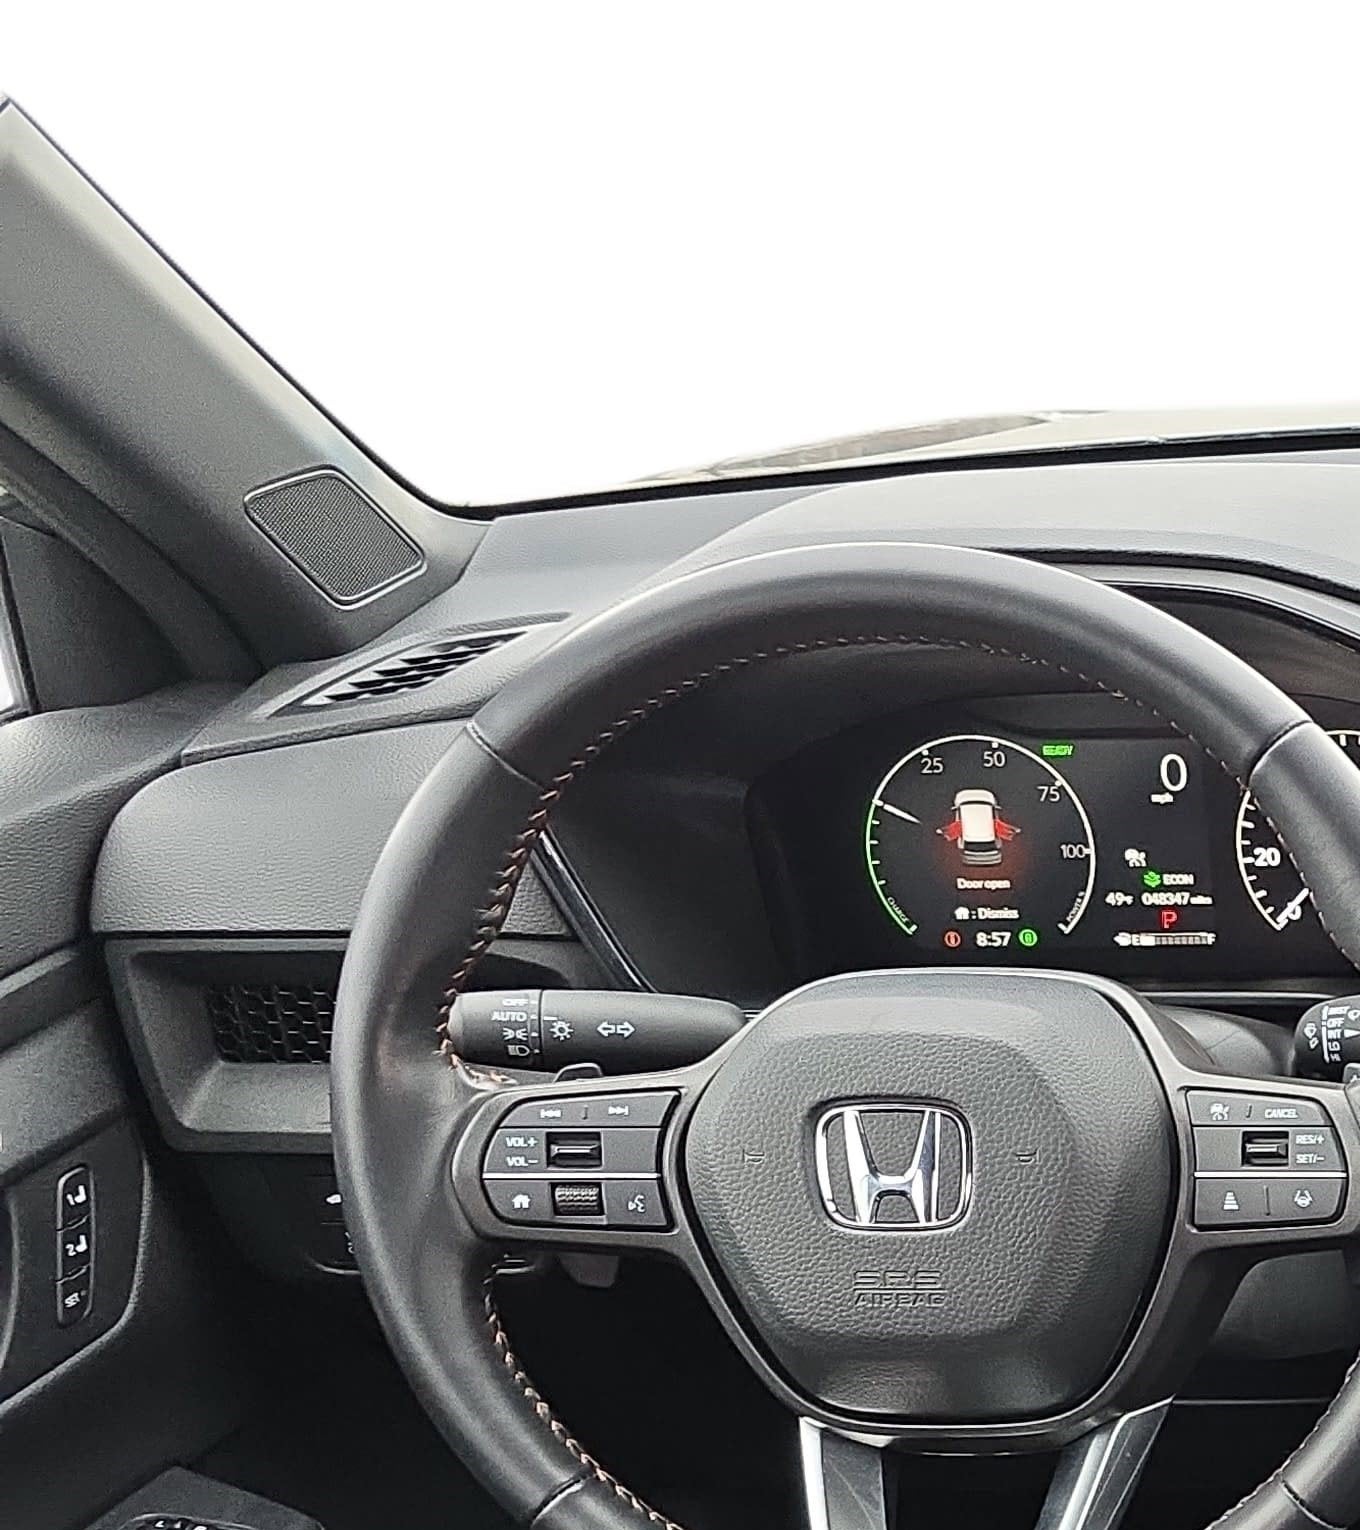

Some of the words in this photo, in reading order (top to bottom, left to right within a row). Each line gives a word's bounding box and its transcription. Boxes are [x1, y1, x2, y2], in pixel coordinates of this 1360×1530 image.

[920, 757, 944, 774] 25
[983, 751, 1006, 768] 50
[1160, 753, 1188, 791] 0
[1036, 785, 1061, 802] 75
[1060, 844, 1086, 859] 100
[1253, 847, 1281, 866] 20
[956, 877, 983, 890] Door
[1163, 873, 1194, 885] ECON
[1141, 892, 1190, 906] 048347
[1162, 910, 1178, 929] P
[975, 931, 1012, 947] 8:57
[491, 1011, 528, 1022] AUTO
[1264, 1108, 1299, 1119] CANCEL
[853, 1269, 943, 1290] SRS
[853, 1292, 947, 1308] AIRBAG
